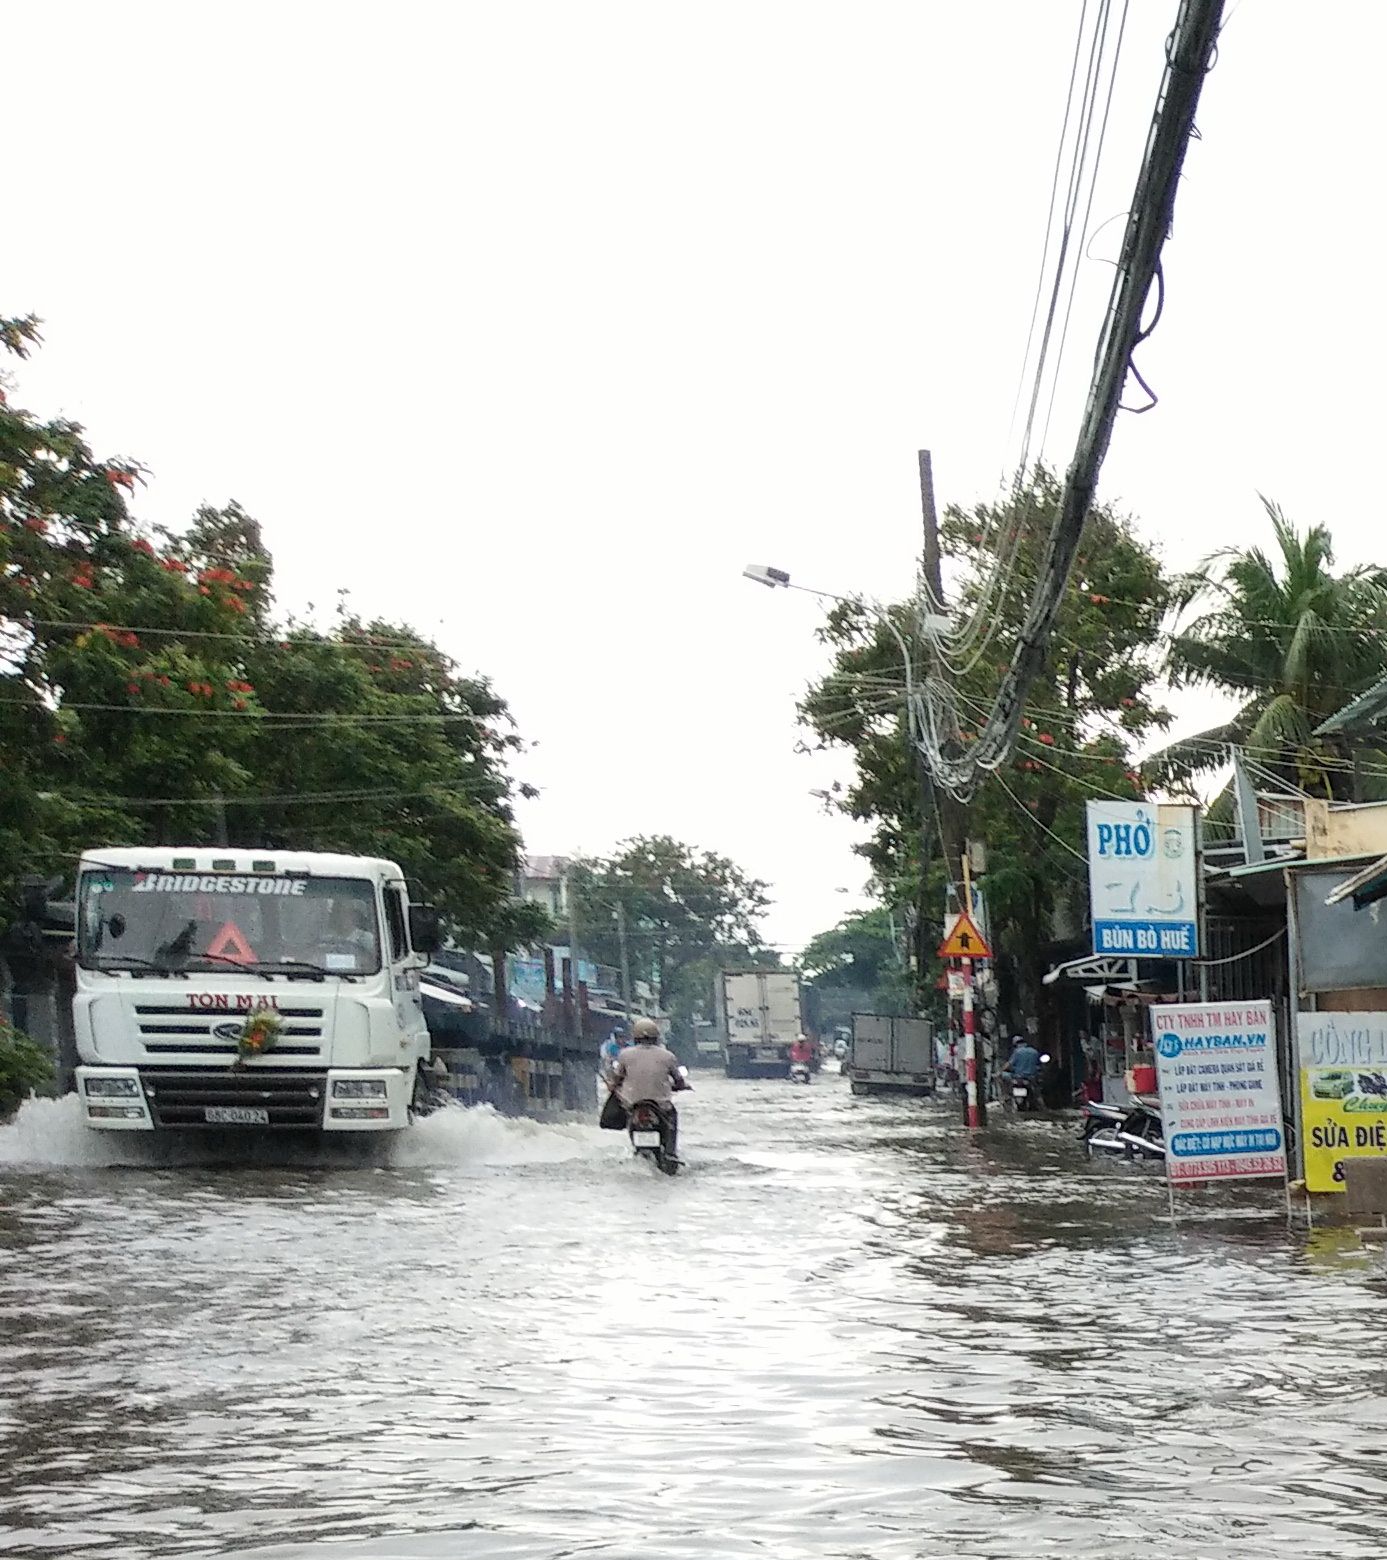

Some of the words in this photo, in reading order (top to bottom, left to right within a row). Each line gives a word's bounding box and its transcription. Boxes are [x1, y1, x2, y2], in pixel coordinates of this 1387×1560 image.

[1096, 809, 1151, 856] PHỞ
[132, 873, 307, 896] BRIDGESTONE
[1102, 925, 1134, 949] BÚN
[1137, 925, 1157, 949] BÒ
[1161, 924, 1190, 950] HUẾ
[1177, 1012, 1205, 1029] TNHH
[1207, 1011, 1222, 1028] TM
[1224, 1010, 1243, 1027] HAY
[1183, 1033, 1266, 1049] HAYBAN.VN
[1312, 1118, 1350, 1148] SỬA
